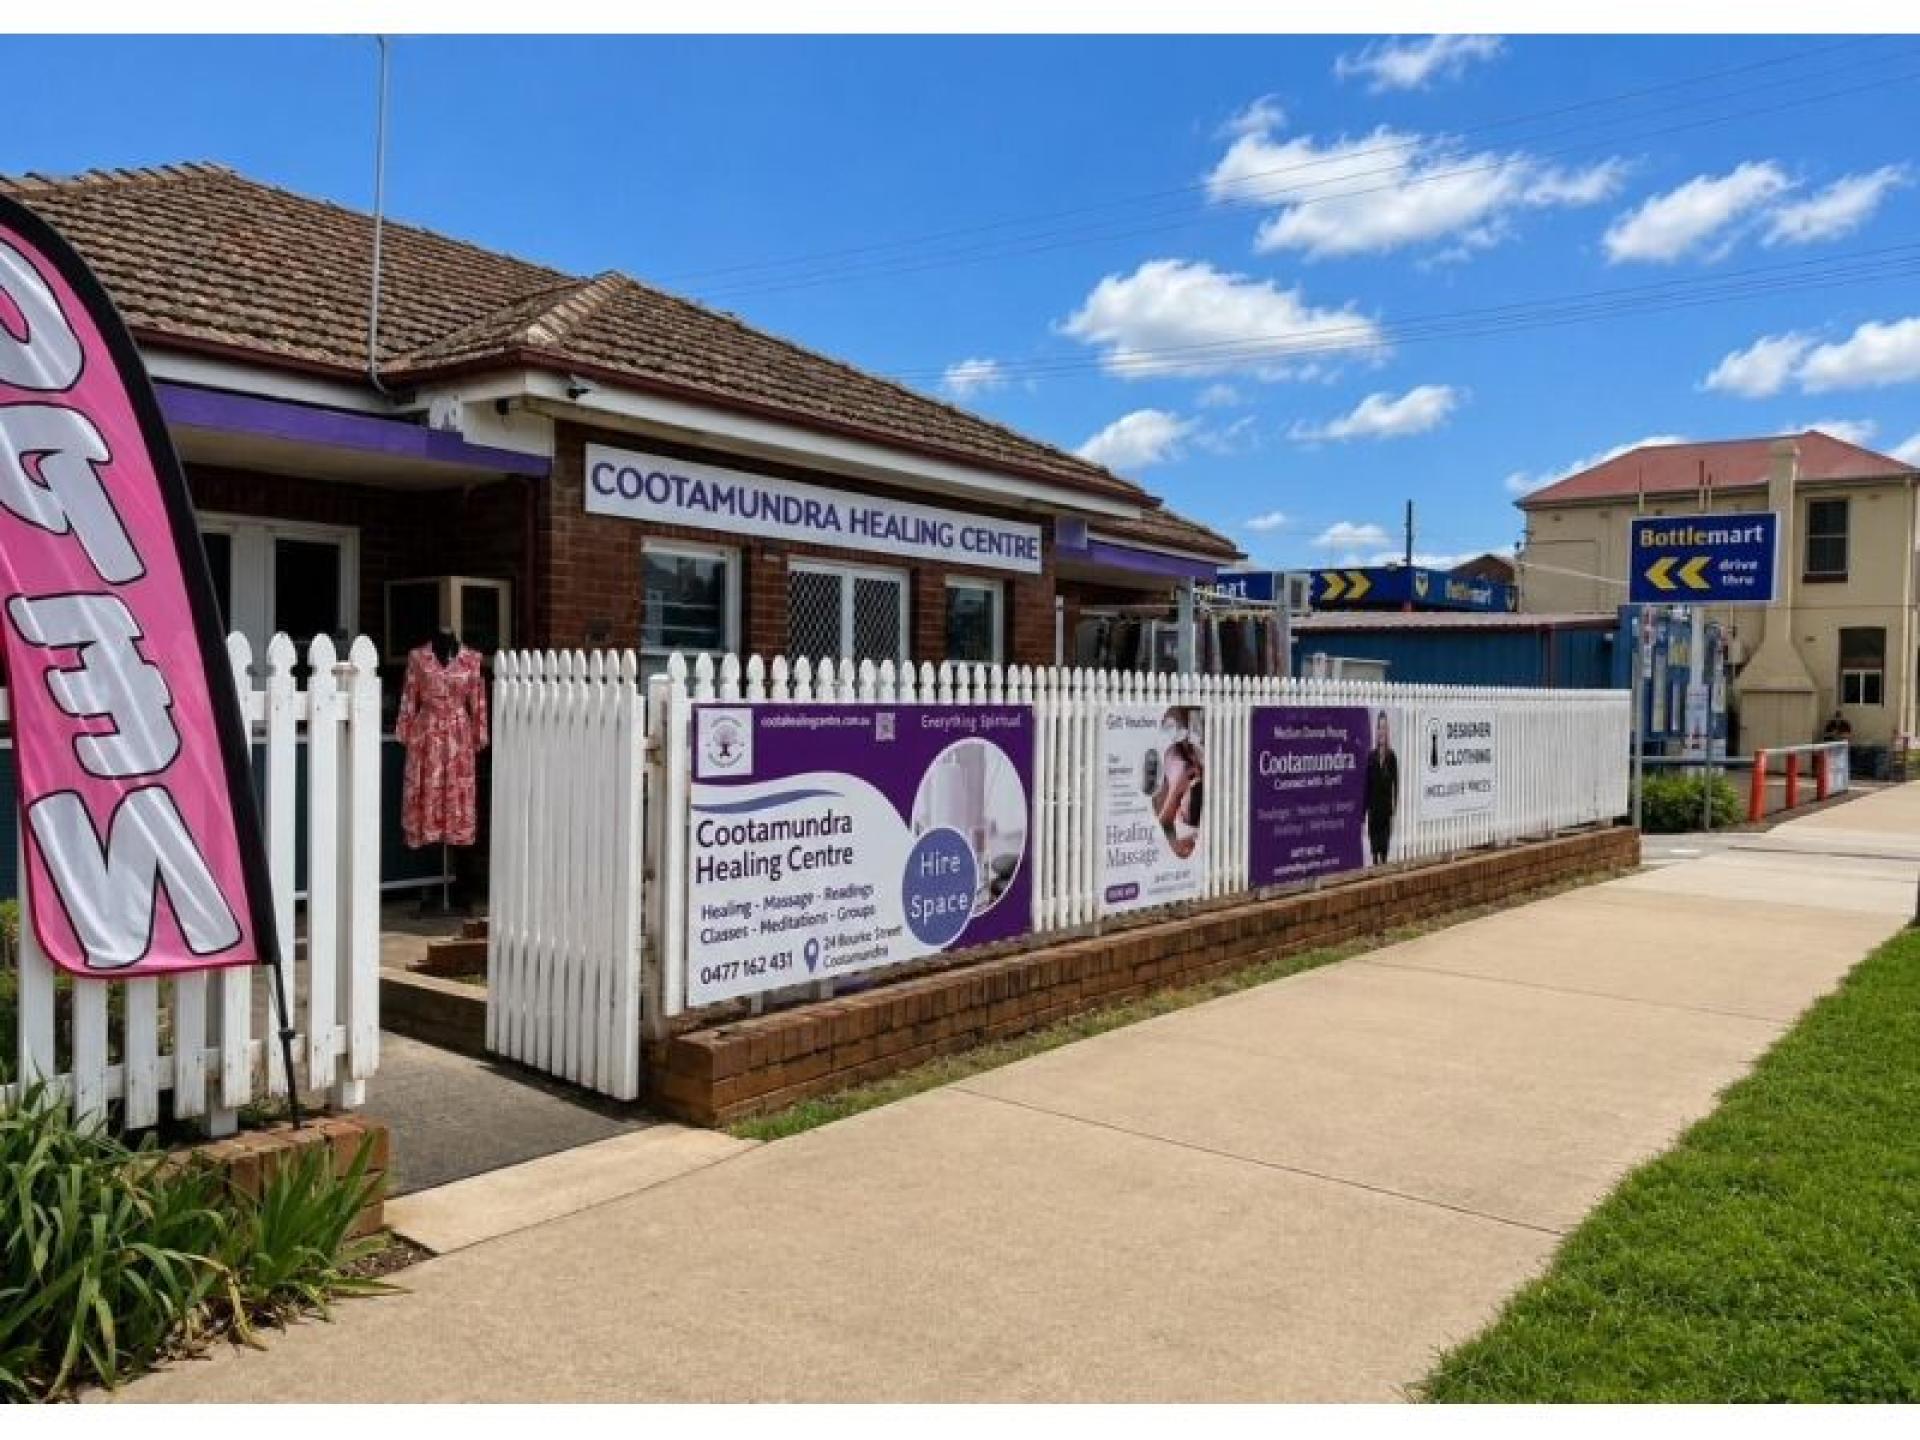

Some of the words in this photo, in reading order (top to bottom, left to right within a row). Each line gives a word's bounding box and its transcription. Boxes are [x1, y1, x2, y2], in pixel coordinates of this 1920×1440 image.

[592, 461, 840, 532] COOTAMUNDRA
[849, 508, 954, 548] HEALING
[959, 526, 1038, 560] CENTRE
[1640, 525, 1764, 547] Bottlemart
[1719, 559, 1758, 571] drive
[921, 714, 979, 732] Everything
[1446, 721, 1491, 739] DESIGNER
[1259, 743, 1356, 776] Cootamundra
[1445, 748, 1492, 767] CLOTHING
[696, 809, 853, 848] Cootamundra
[1106, 821, 1155, 846] Healing
[695, 848, 782, 884] Healing
[787, 845, 853, 873] Centre
[920, 852, 961, 876] Hire
[1106, 847, 1159, 869] Massage
[701, 901, 751, 922] Healing
[763, 890, 815, 911] Massage
[825, 883, 875, 901] Readings
[911, 891, 968, 927] Space
[701, 926, 749, 945] Classes
[760, 910, 829, 935] Meditations
[837, 902, 876, 922] Groups
[874, 925, 903, 941] Street
[701, 960, 739, 985] 0477
[743, 956, 767, 980] 162
[769, 950, 793, 971] 431
[823, 944, 888, 968] Cootamundra
